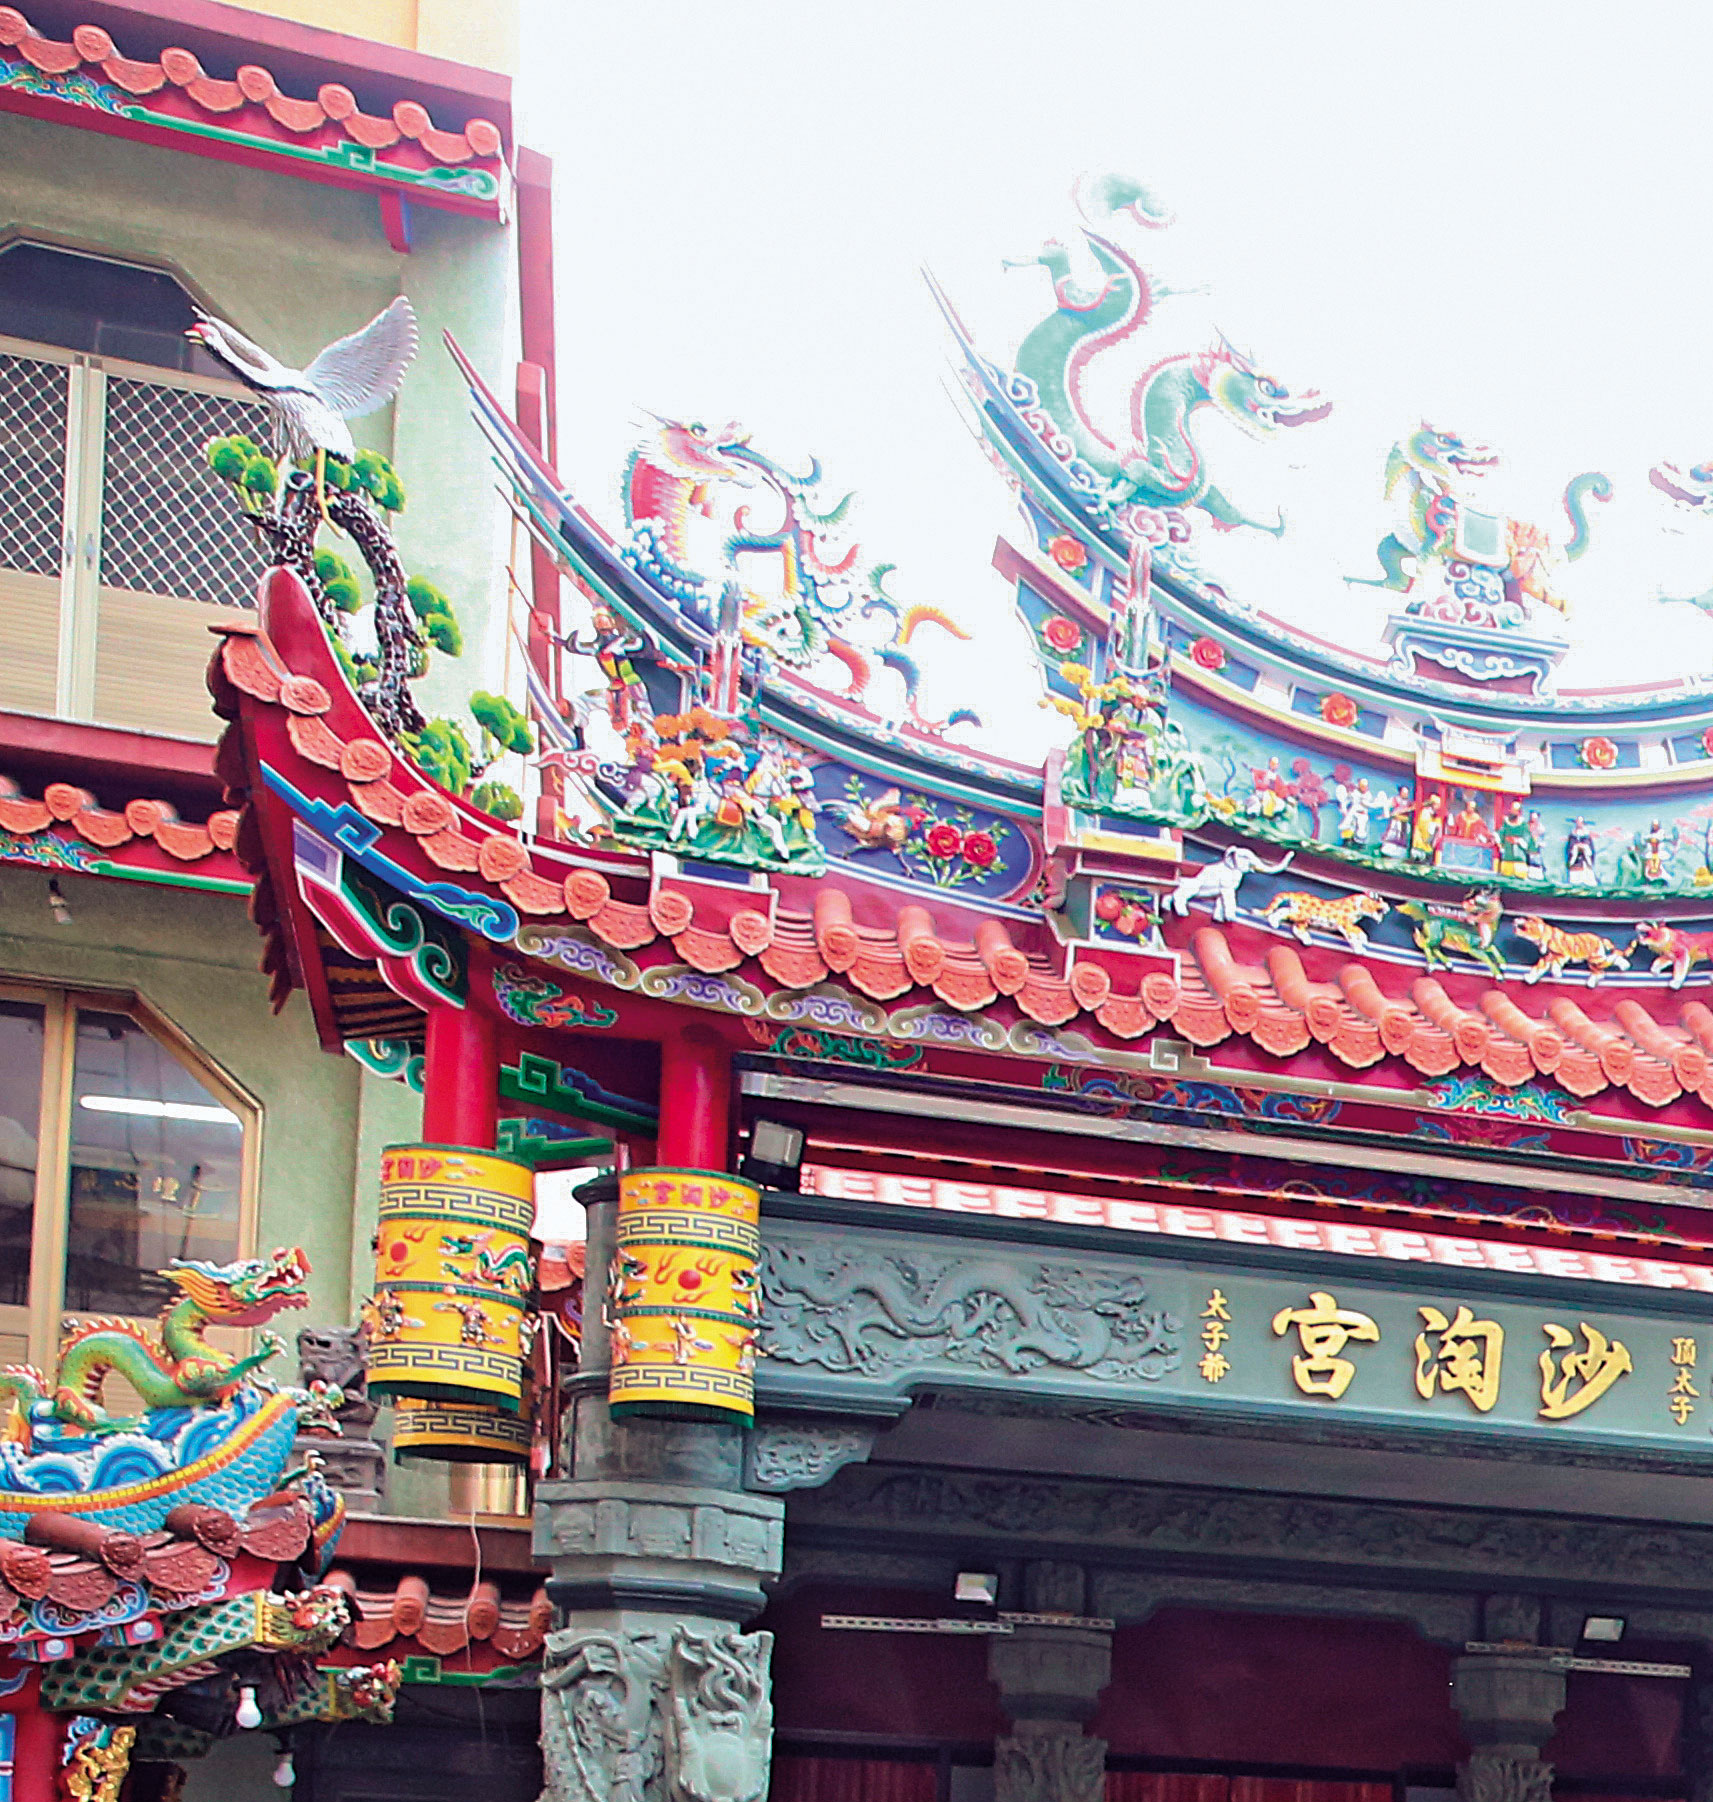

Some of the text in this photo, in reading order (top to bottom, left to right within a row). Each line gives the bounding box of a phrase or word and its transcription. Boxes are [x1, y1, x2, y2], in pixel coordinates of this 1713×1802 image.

[1271, 1291, 1633, 1420] 沙淘宮
[1668, 1337, 1699, 1425] 頂太子
